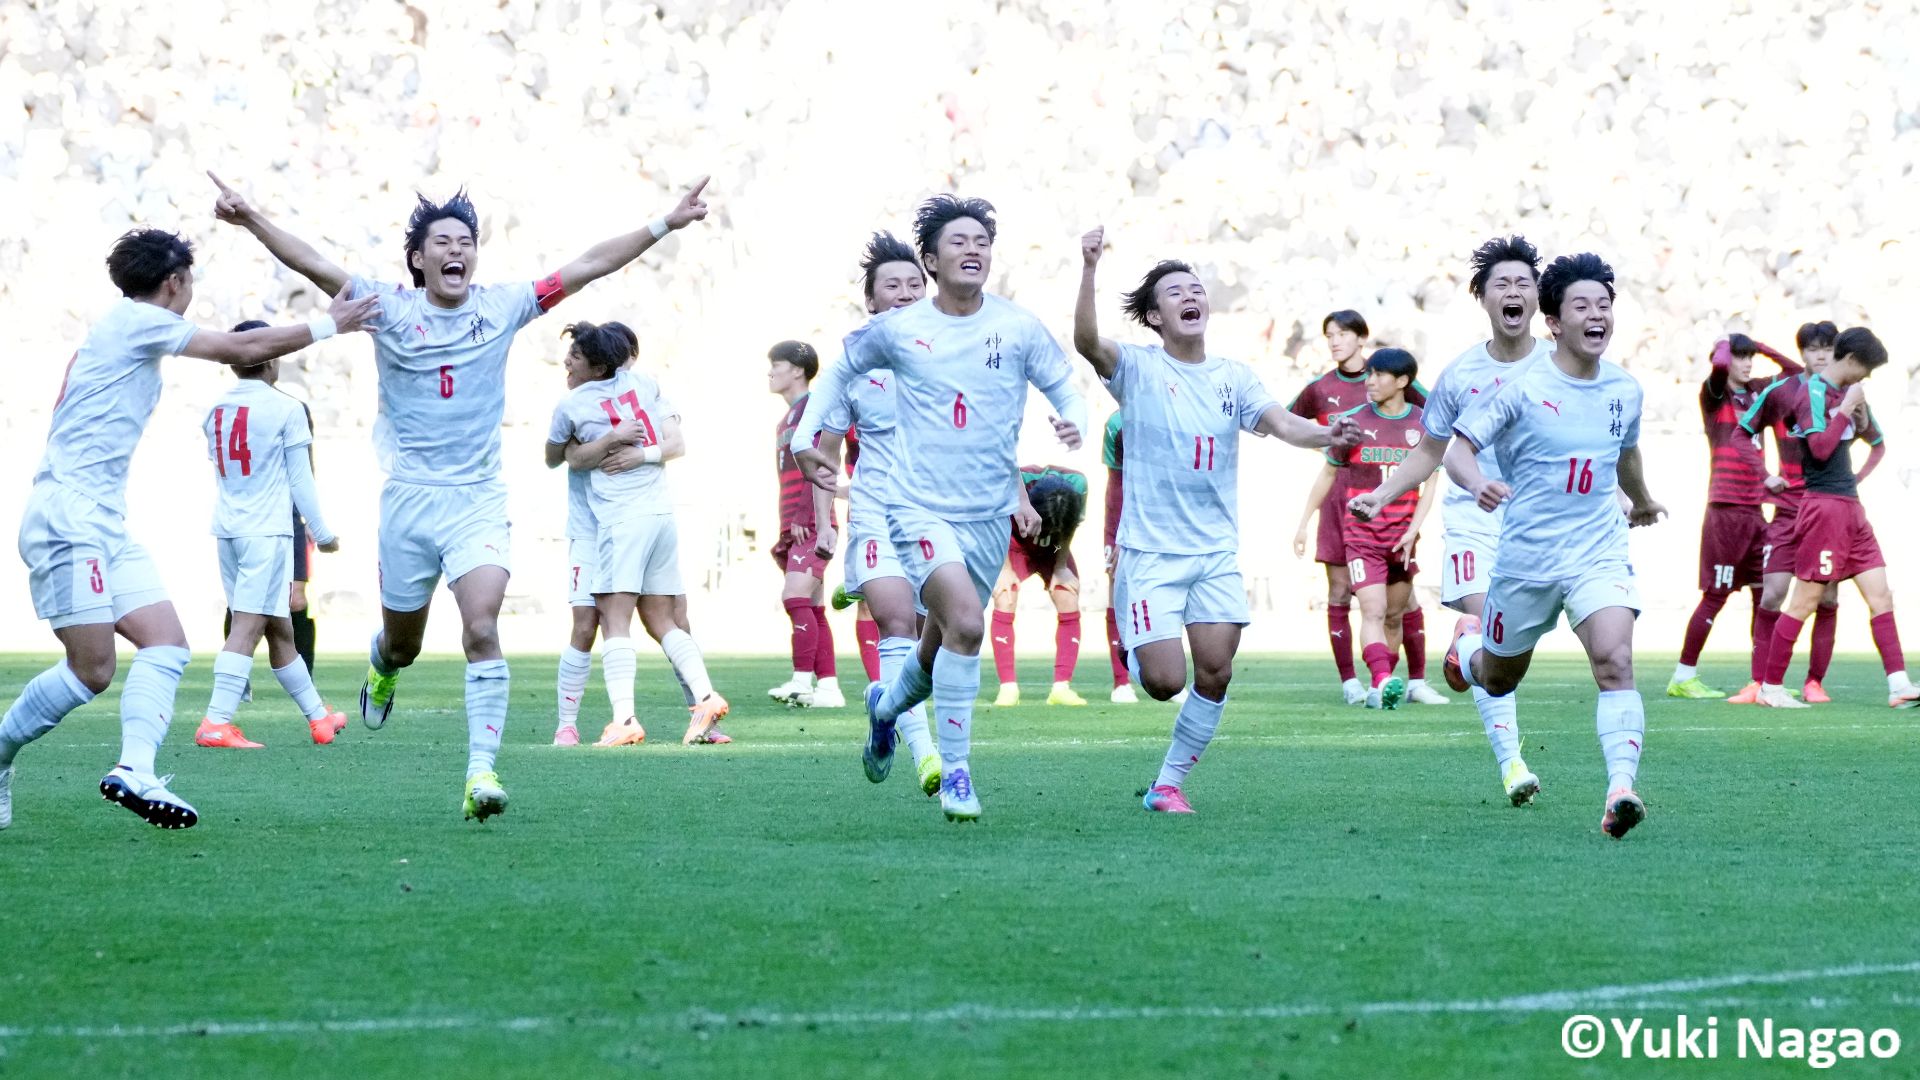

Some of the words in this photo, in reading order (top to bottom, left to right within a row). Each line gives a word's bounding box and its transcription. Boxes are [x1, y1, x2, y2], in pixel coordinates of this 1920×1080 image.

[984, 331, 1003, 370] 神村
[439, 364, 454, 399] 5
[1218, 381, 1234, 417] 神村
[953, 391, 967, 429] 6
[1608, 398, 1623, 438] 神村
[214, 406, 252, 478] 14
[1193, 434, 1215, 471] 11
[1565, 457, 1594, 495] 16
[865, 539, 878, 569] 8
[1347, 557, 1366, 585] 18
[1450, 549, 1475, 585] 10
[1819, 550, 1833, 576] 5
[86, 559, 104, 595] 3
[1713, 564, 1735, 589] 14
[1131, 599, 1151, 634] 11
[1486, 604, 1504, 645] 16
